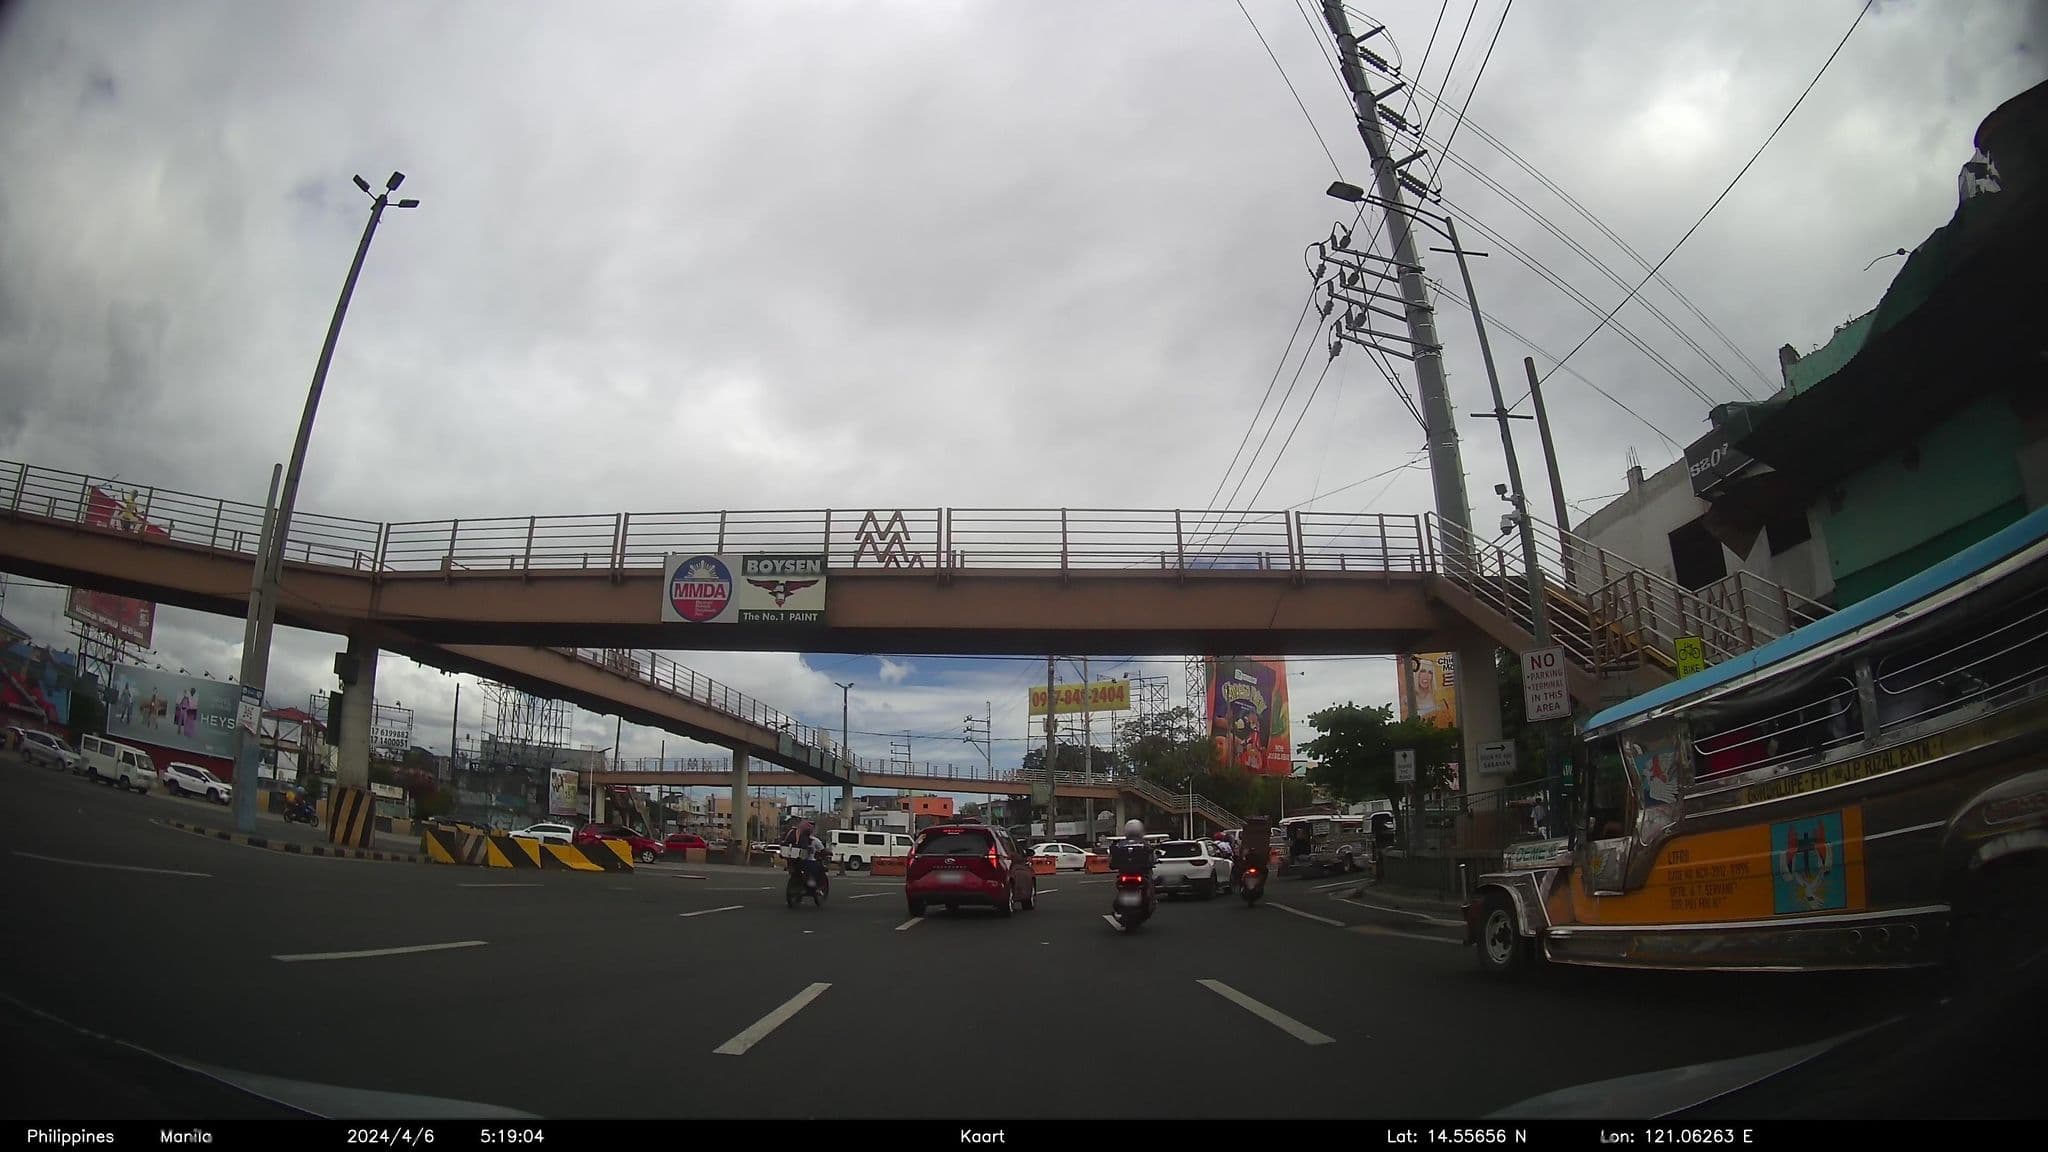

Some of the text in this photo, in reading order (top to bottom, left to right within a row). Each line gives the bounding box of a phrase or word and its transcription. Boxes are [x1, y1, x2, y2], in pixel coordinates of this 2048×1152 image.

[747, 559, 821, 573] BOYSEN
[674, 583, 726, 598] MMDA
[743, 612, 760, 621] The
[789, 612, 818, 621] PAINT
[1531, 653, 1555, 670] NO
[1530, 669, 1563, 681] PARKING
[1683, 664, 1700, 675] BIKE
[1032, 686, 1125, 707] 097-84-2404
[1531, 690, 1563, 703] IN THIS
[1536, 702, 1560, 713] AREA
